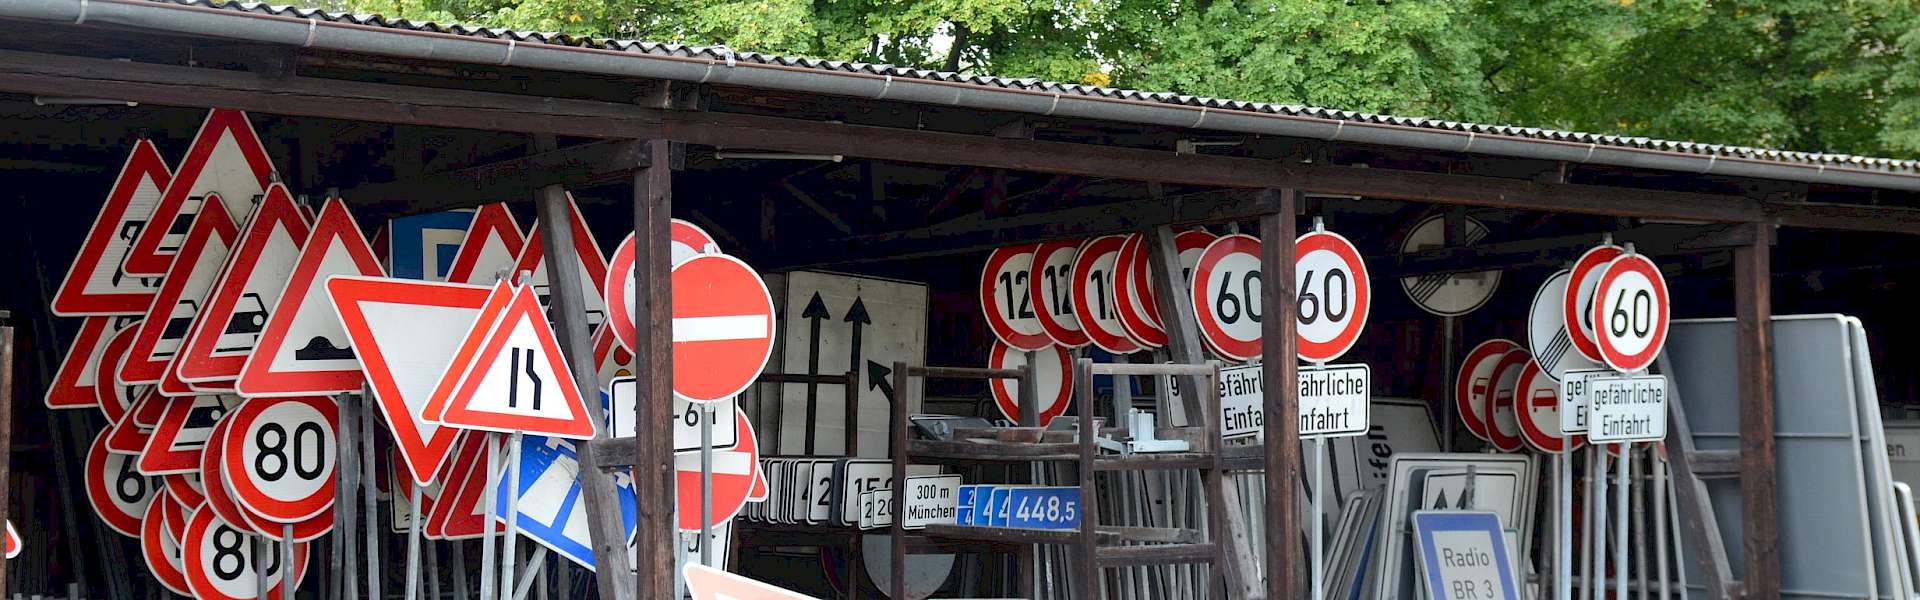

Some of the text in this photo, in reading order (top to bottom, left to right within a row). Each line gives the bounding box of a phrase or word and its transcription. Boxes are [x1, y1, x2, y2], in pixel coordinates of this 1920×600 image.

[1216, 270, 1262, 324] 60
[1297, 268, 1348, 325] 60
[1611, 288, 1651, 338] 60
[1566, 374, 1590, 402] gef
[1594, 384, 1662, 411] gefährliche
[1301, 407, 1349, 431] nfahrt
[1602, 414, 1651, 436] Einfahrt
[254, 421, 325, 481] 80
[917, 484, 949, 500] 300 m
[908, 504, 955, 520] München
[1015, 495, 1076, 522] 448,5
[213, 523, 281, 581] 80
[1442, 547, 1490, 567] Radio
[1452, 579, 1494, 600] BR 3
